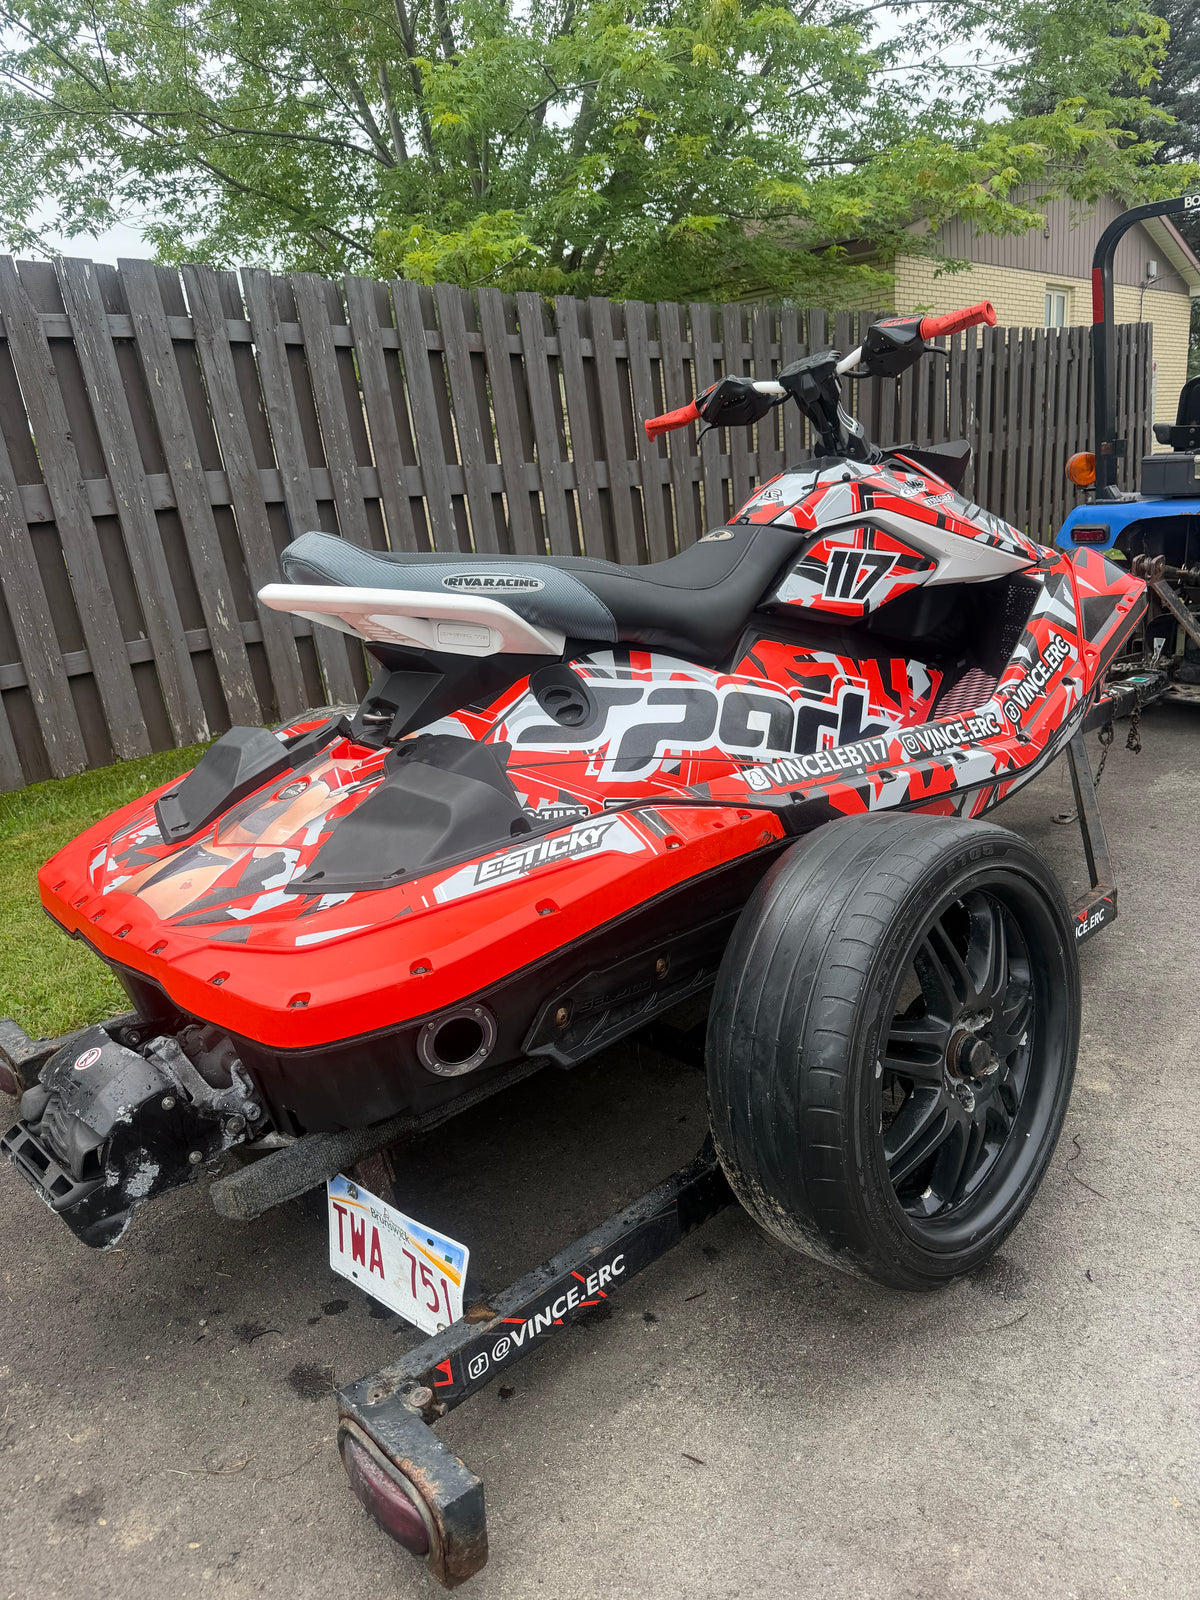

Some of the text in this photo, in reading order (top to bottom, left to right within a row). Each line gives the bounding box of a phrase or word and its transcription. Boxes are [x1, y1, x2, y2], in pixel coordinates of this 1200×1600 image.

[823, 549, 899, 603] 117
[1012, 635, 1070, 710] VINCE.ERC
[762, 739, 887, 784] VINCELEB117
[917, 714, 1001, 749] VINCE.ERC
[476, 824, 610, 884] ESTICKY
[332, 1202, 453, 1325] TWA 751
[492, 1254, 626, 1362] @VINCE.ERC
